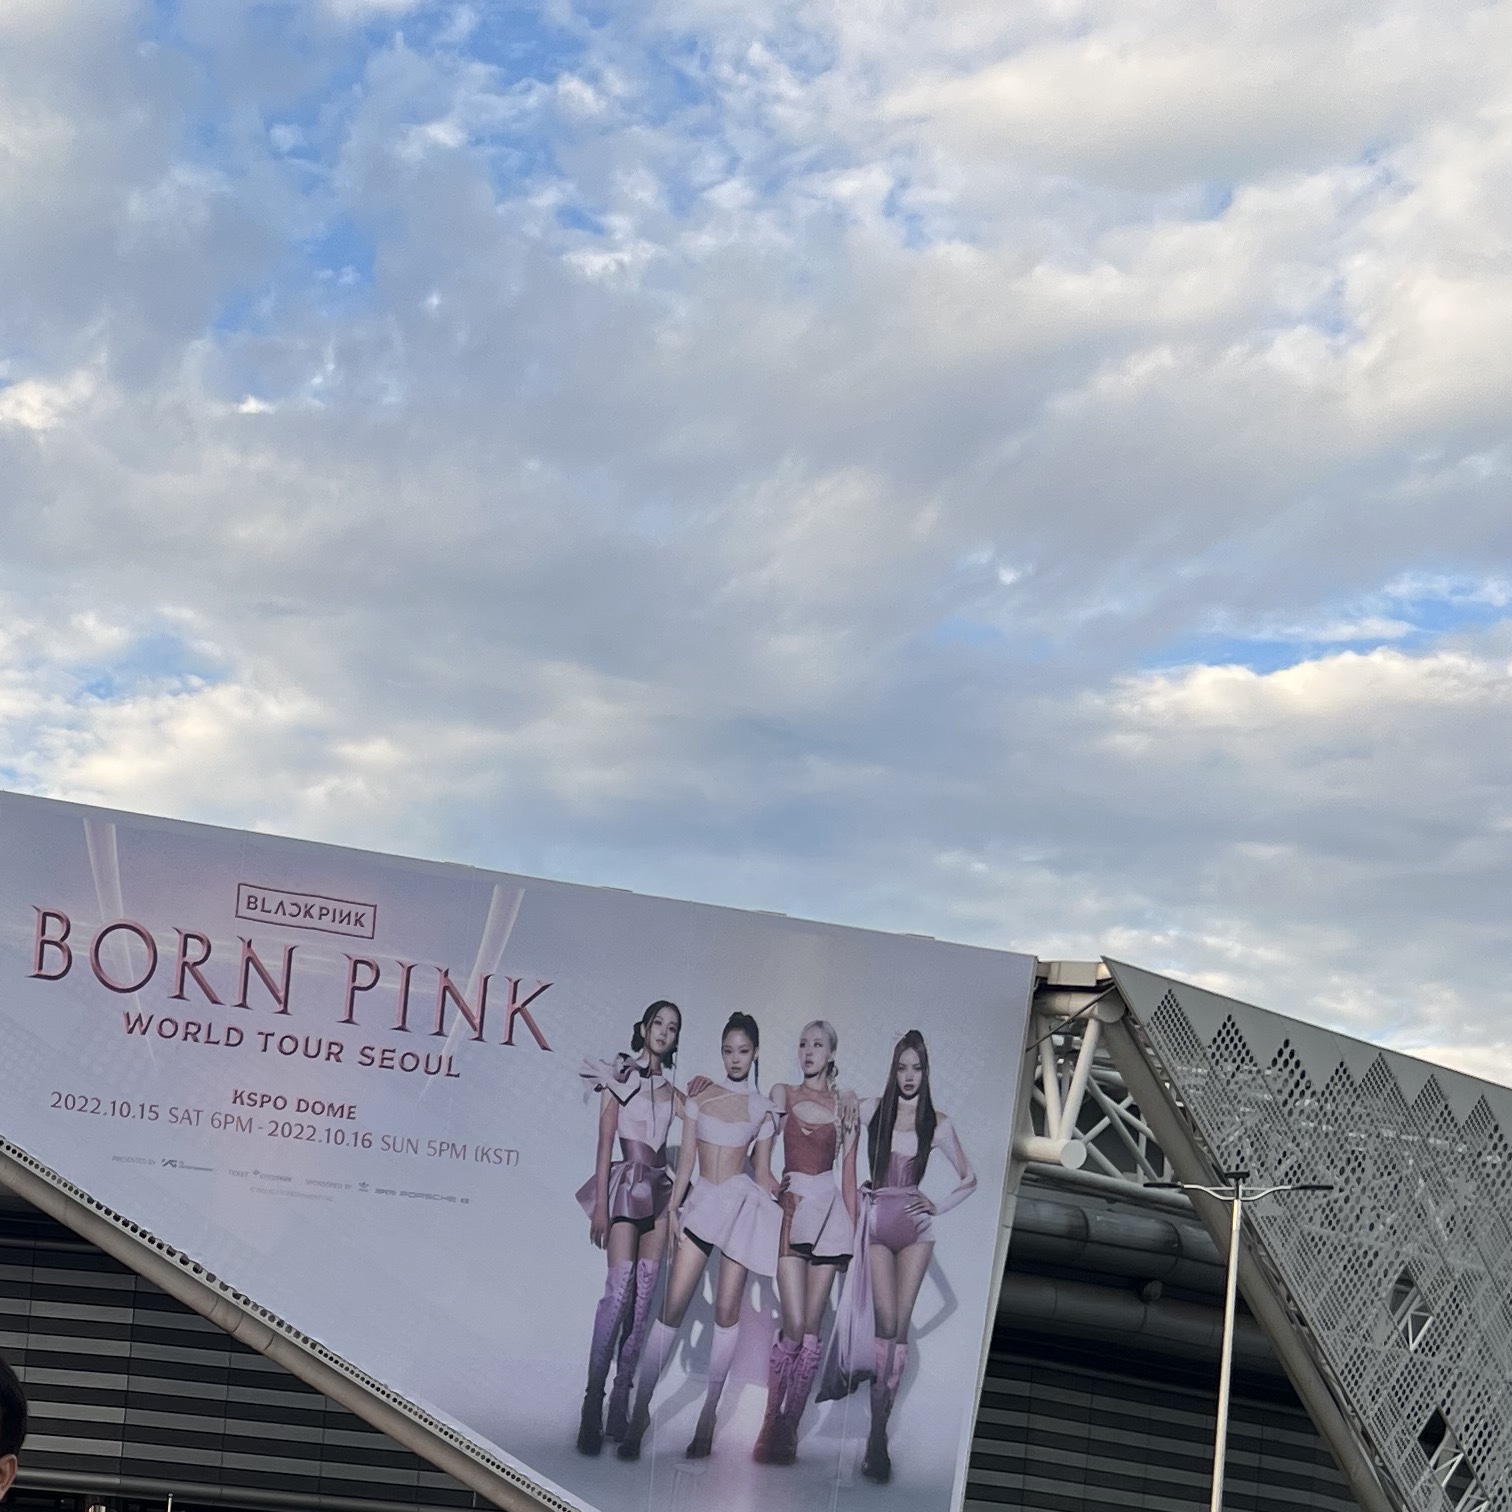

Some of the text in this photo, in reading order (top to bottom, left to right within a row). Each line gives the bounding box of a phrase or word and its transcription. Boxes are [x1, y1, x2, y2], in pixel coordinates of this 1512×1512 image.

[27, 904, 555, 1052] BORN PINK
[123, 1010, 461, 1079] WORLD TOUR SEOUL
[50, 1091, 159, 1121] 2022.10.15
[168, 1106, 204, 1127] SAT
[210, 1112, 253, 1134] 6PM
[268, 1120, 373, 1149] 2022.10.16
[381, 1134, 419, 1155] SUN
[426, 1139, 467, 1161] 5PM
[474, 1144, 520, 1167] (KST)
[232, 1089, 357, 1121] KSPO DOME
